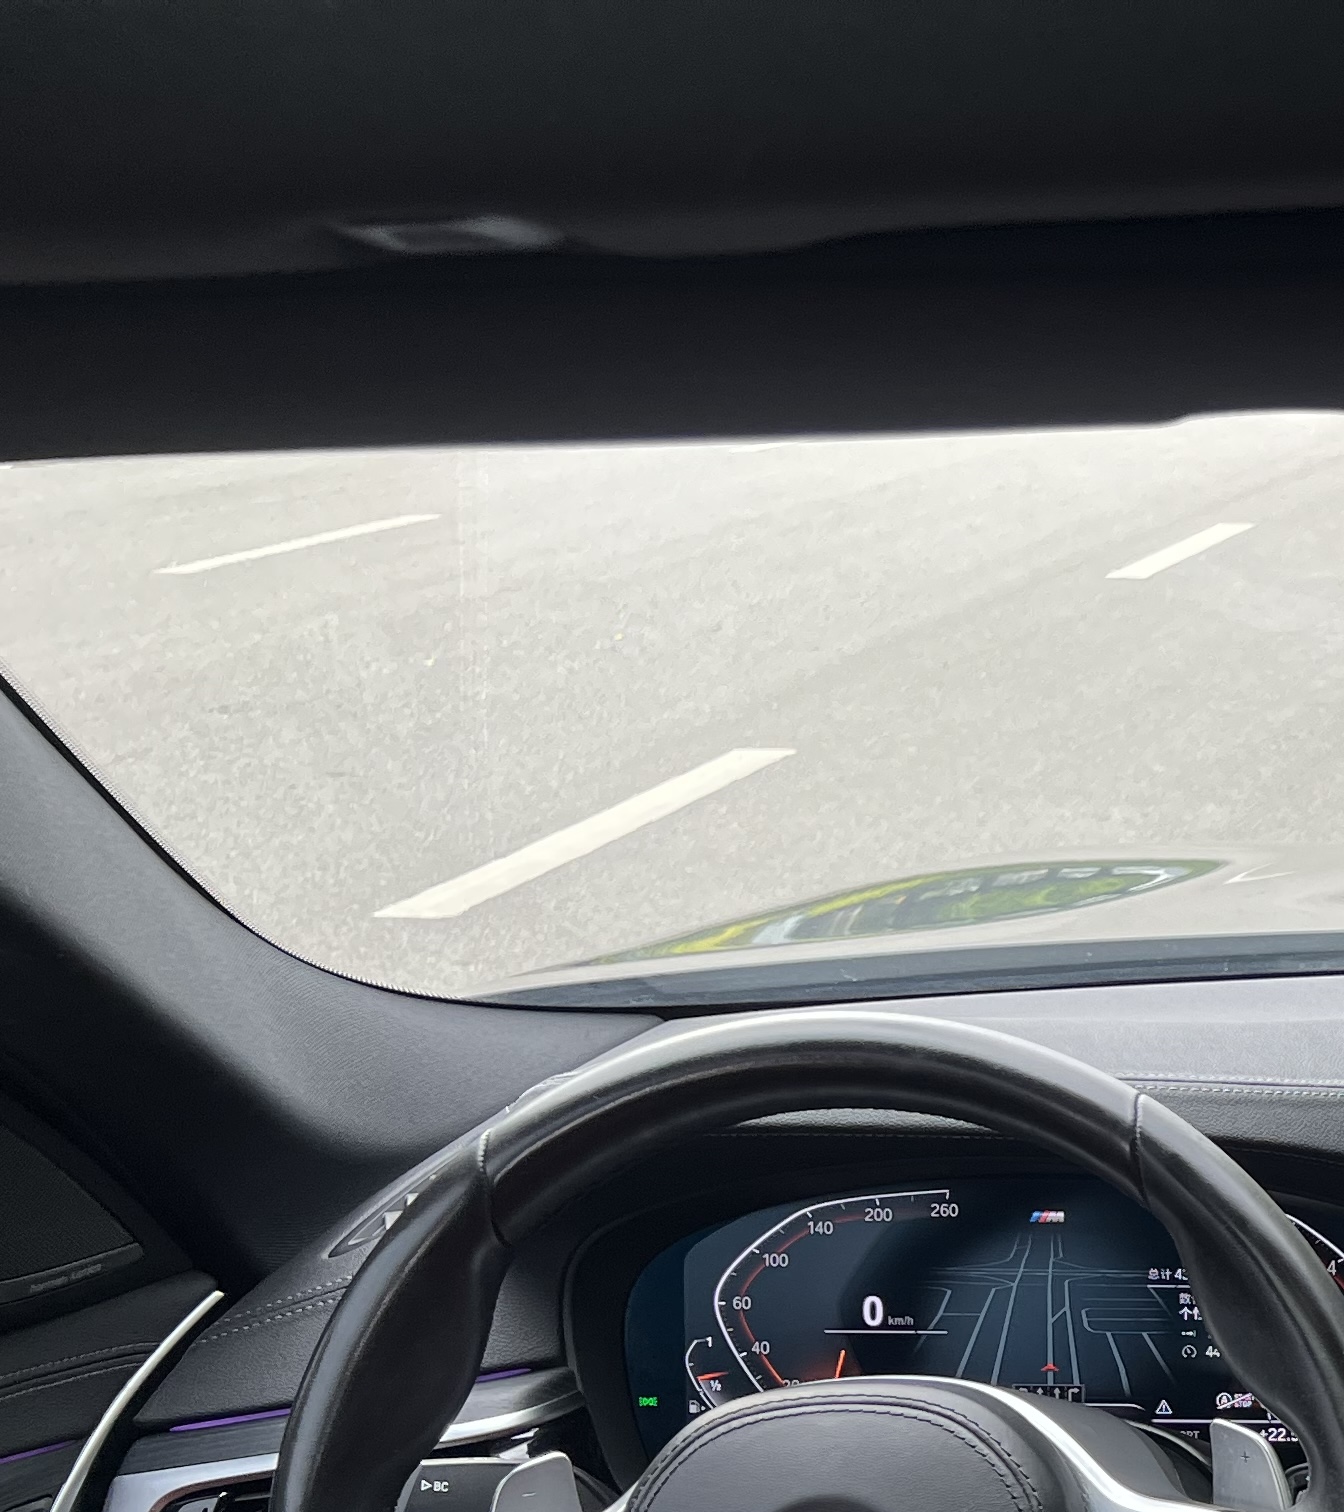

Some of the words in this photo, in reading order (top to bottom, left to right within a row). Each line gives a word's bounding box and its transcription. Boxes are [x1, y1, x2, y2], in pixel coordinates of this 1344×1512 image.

[864, 1208, 893, 1222] 200
[930, 1203, 959, 1218] 260
[807, 1220, 834, 1235] 140
[762, 1253, 789, 1268] 100
[1326, 1260, 1337, 1276] 4
[732, 1296, 752, 1310] 60
[862, 1295, 884, 1327] 0
[888, 1315, 914, 1326] km/h
[751, 1341, 770, 1355] 40
[433, 1480, 449, 1493] BC
